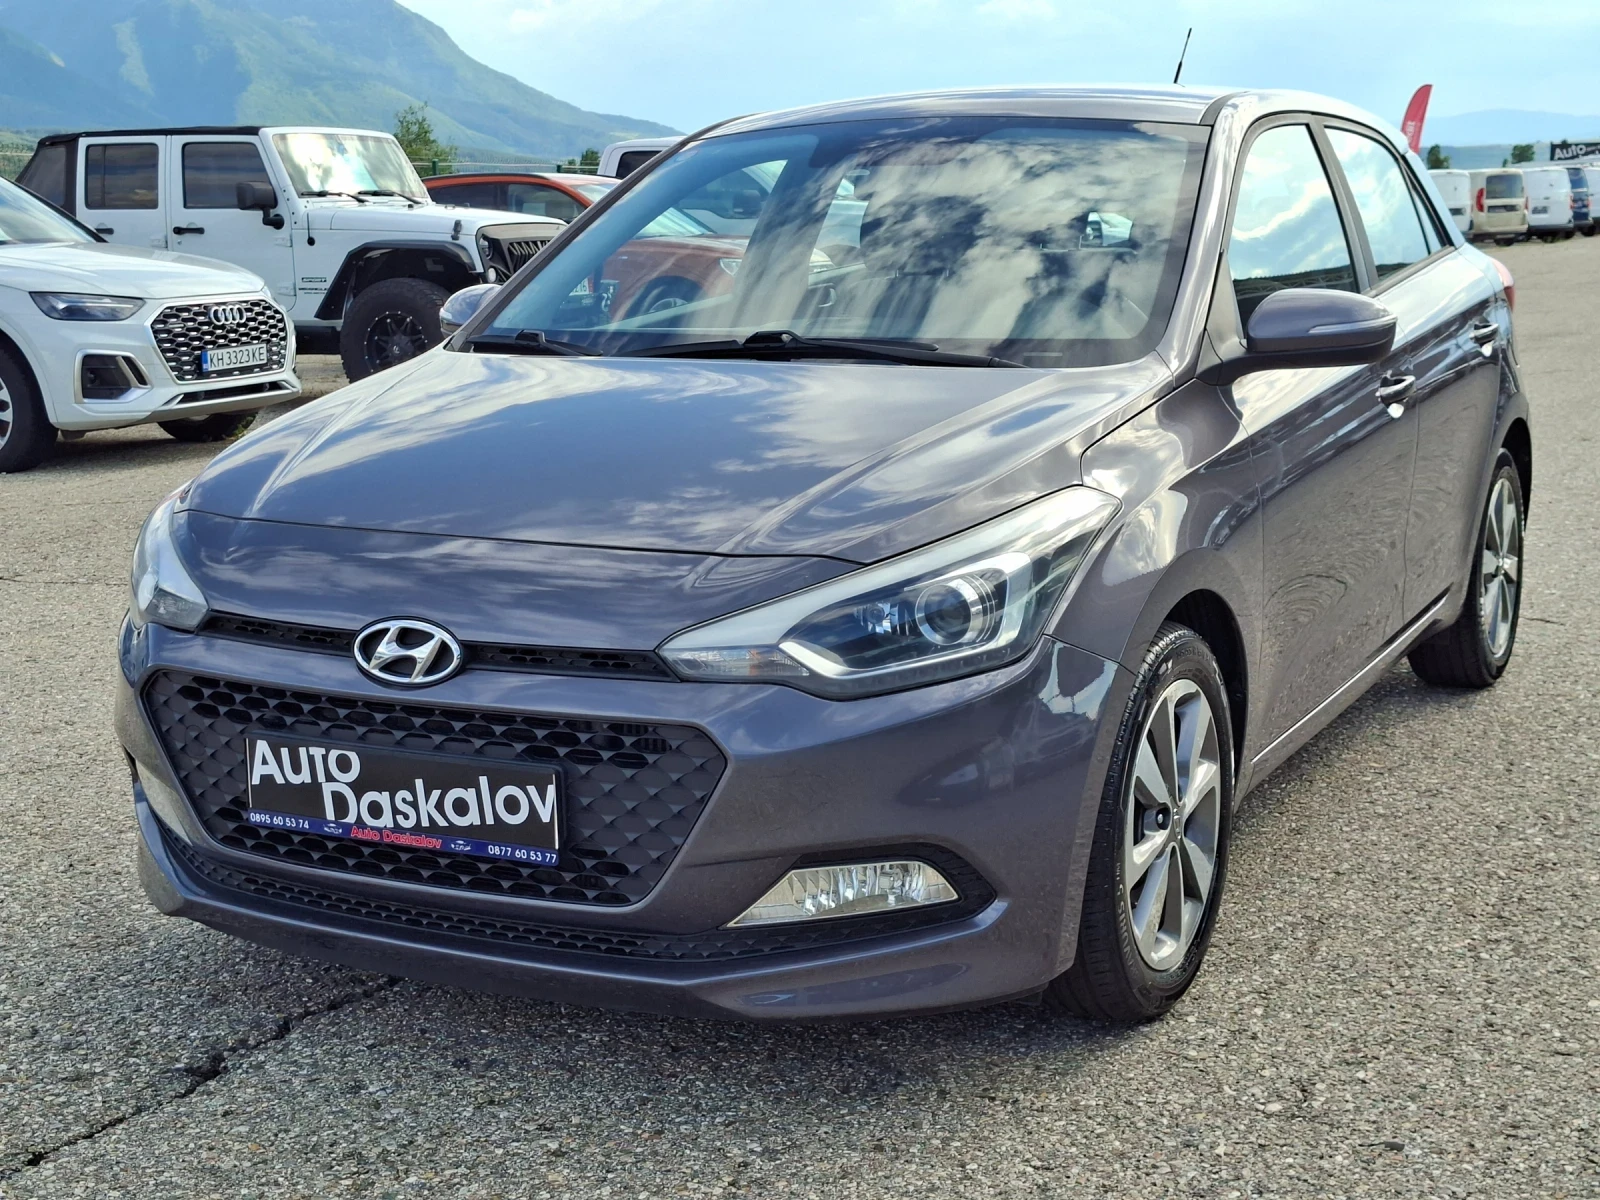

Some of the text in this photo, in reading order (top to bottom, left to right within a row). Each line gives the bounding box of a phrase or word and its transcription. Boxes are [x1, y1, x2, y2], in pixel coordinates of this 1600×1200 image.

[1554, 145, 1586, 160] Auto
[322, 775, 556, 829] Daskalov
[250, 812, 309, 829] 0895 60 53 74
[351, 826, 442, 849] Auto Daskalov
[488, 845, 557, 864] 0877 60 53 77
